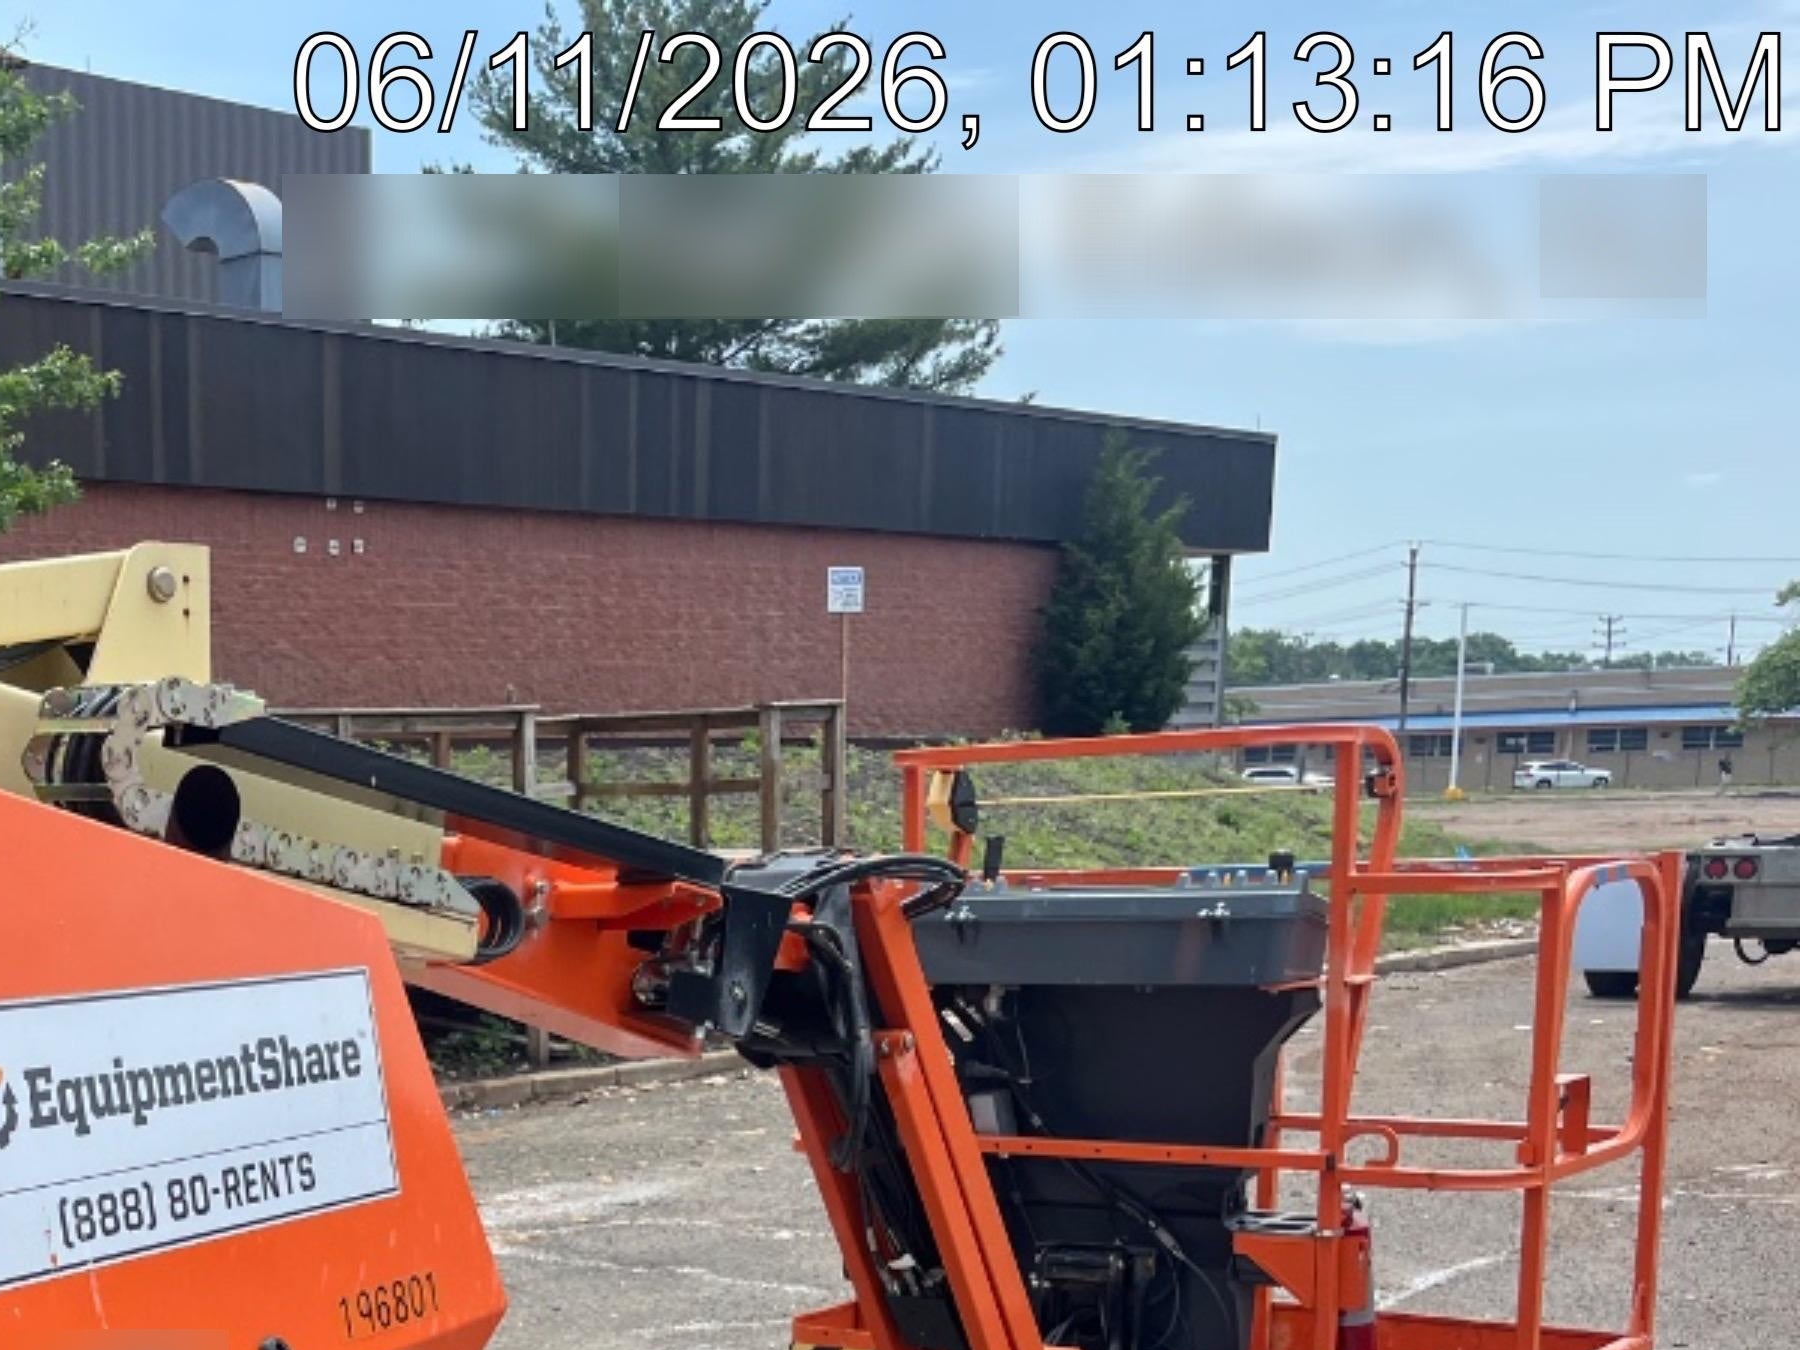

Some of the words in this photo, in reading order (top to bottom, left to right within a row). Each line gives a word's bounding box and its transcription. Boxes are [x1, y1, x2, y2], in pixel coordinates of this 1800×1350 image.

[23, 1035, 361, 1135] EquipmentShare
[59, 1181, 157, 1248] (888)
[166, 1152, 316, 1221] 80-RENTS
[339, 1272, 438, 1338] 196801
